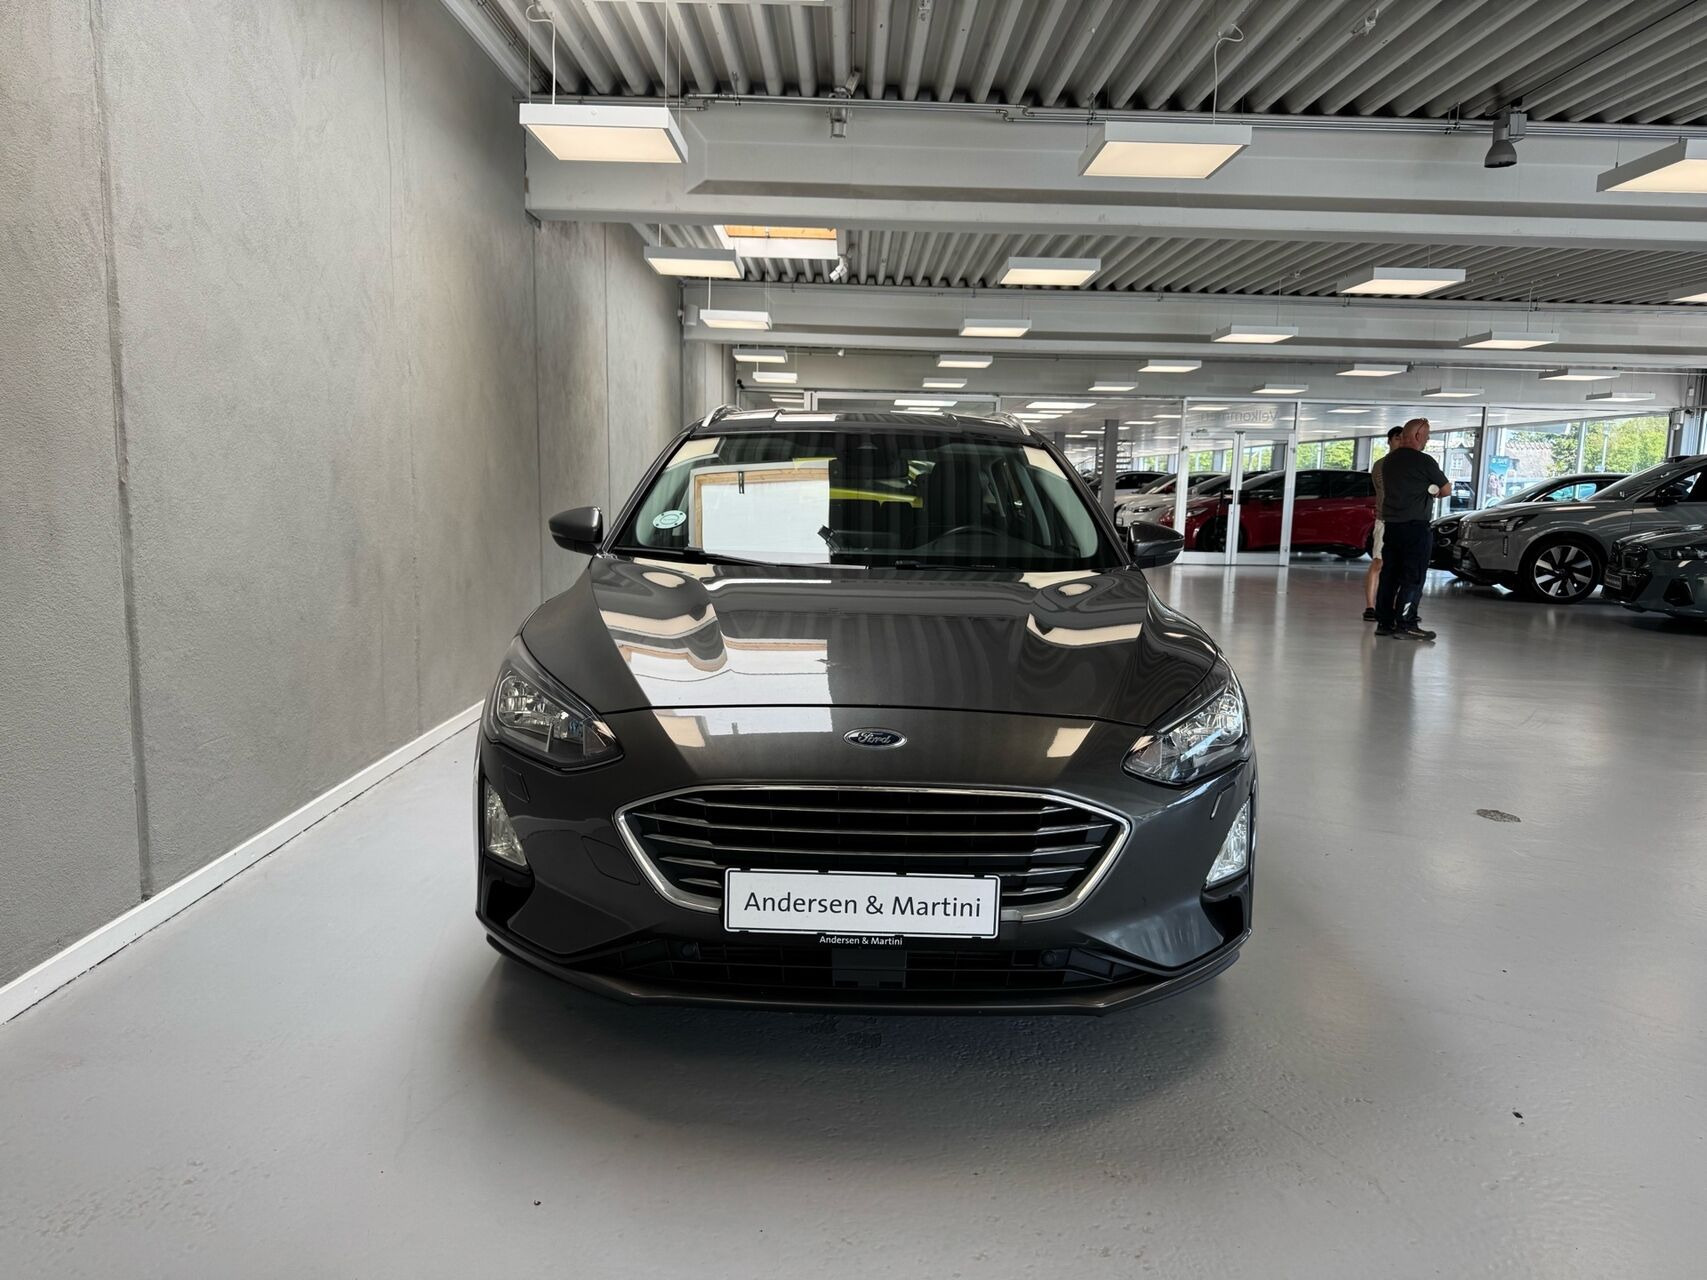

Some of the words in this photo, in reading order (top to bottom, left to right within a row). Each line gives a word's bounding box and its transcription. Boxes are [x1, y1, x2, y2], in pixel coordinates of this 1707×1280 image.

[857, 732, 891, 744] Ford
[744, 891, 857, 914] Andersen
[865, 895, 884, 915] &
[891, 896, 981, 917] Martini
[819, 935, 860, 945] Andersen
[861, 936, 869, 945] &
[870, 937, 903, 946] Martini
